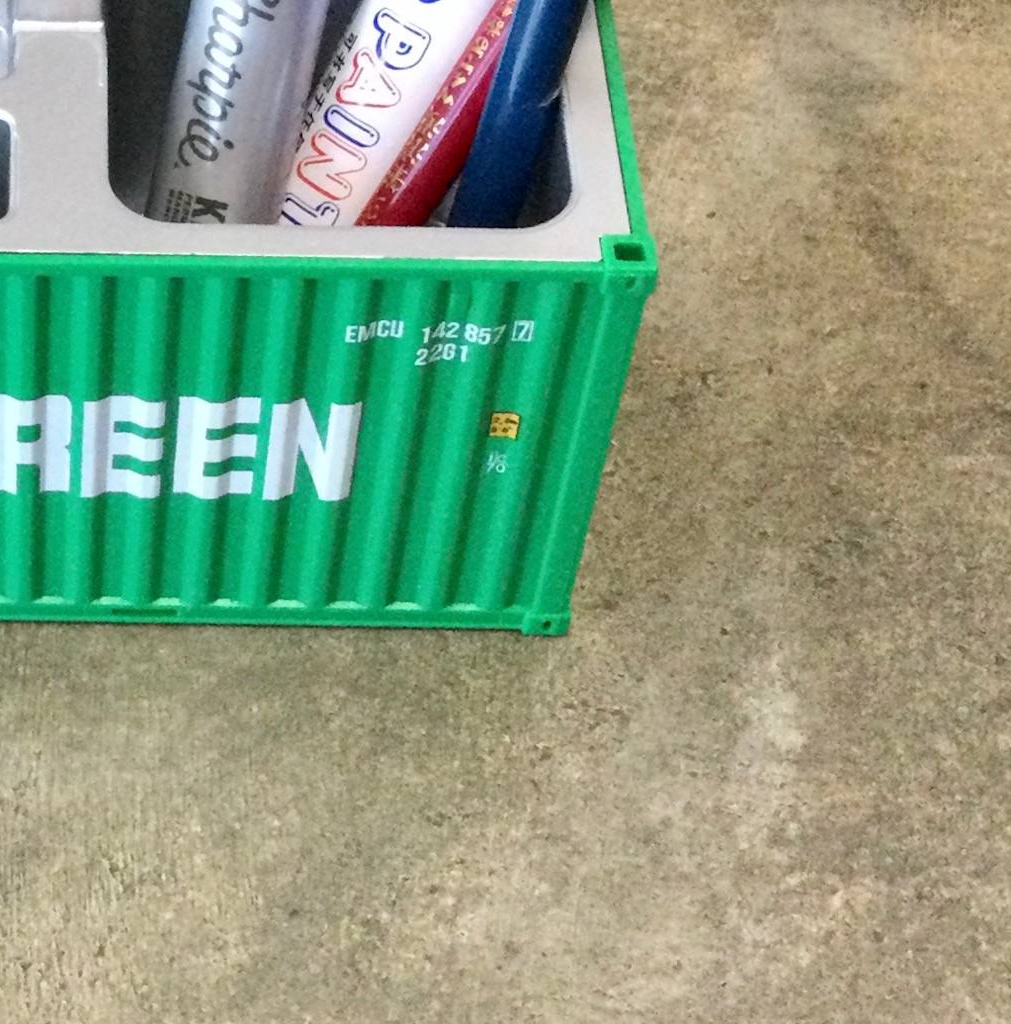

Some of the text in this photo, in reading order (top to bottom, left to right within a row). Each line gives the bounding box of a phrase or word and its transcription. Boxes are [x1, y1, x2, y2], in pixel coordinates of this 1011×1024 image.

[344, 319, 405, 344] EMCU
[513, 320, 534, 342] 7
[414, 342, 469, 367] 22G1
